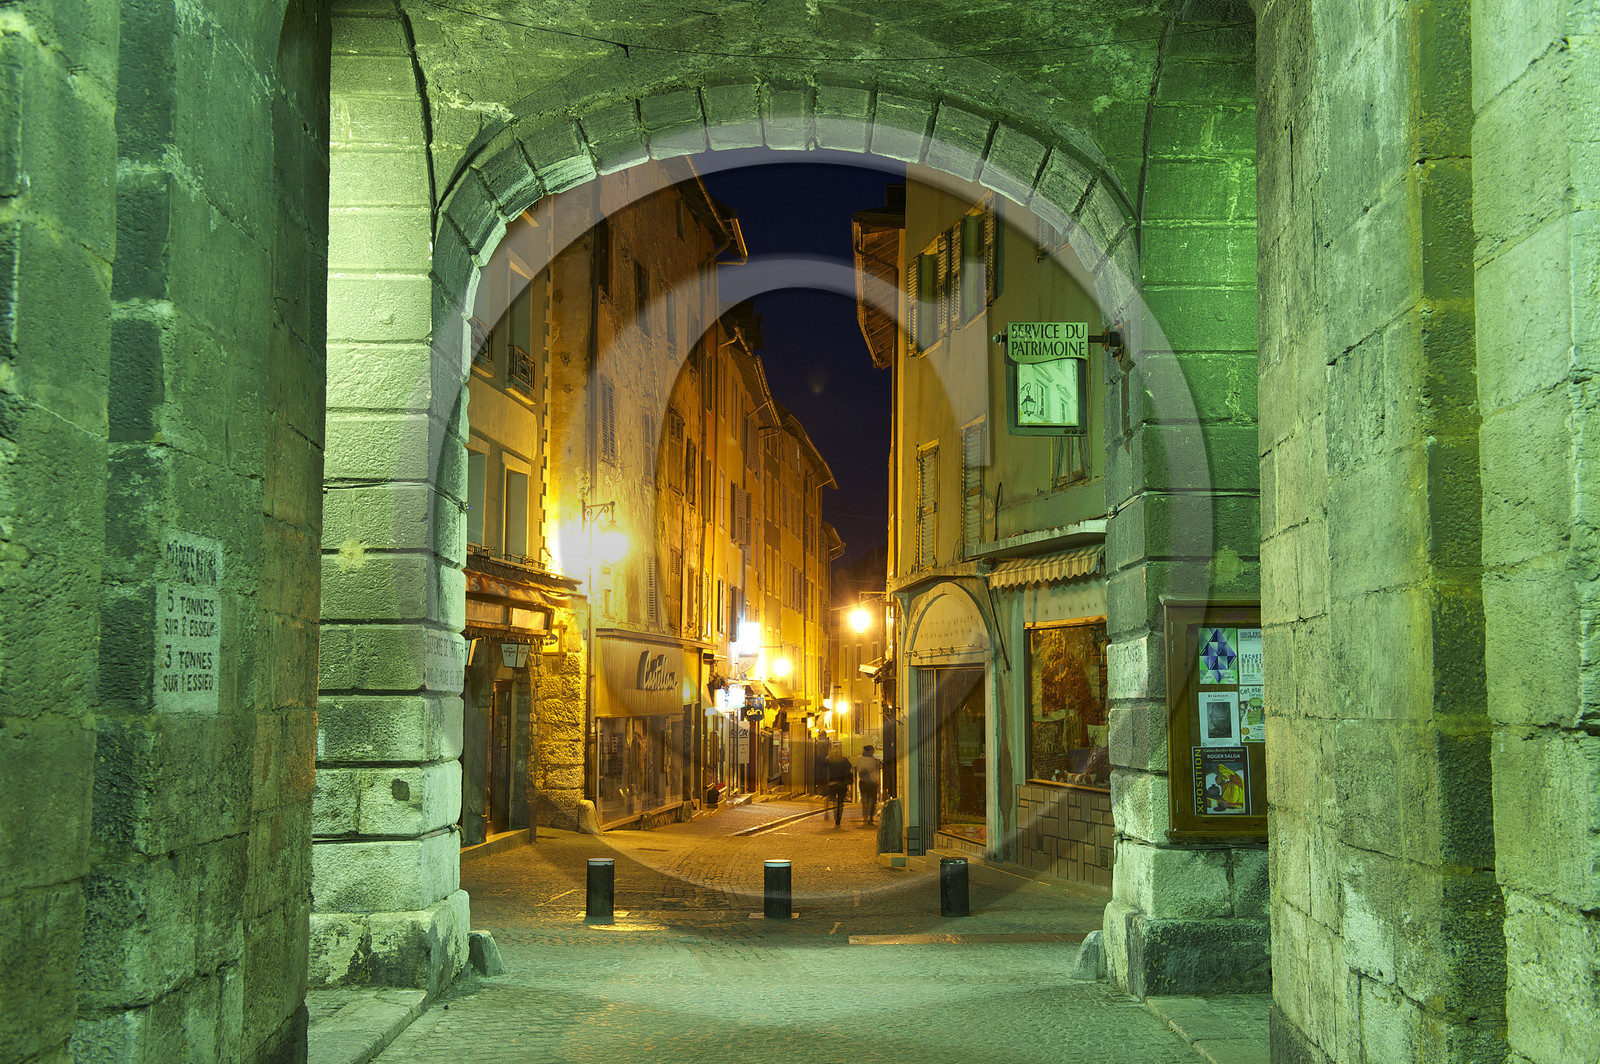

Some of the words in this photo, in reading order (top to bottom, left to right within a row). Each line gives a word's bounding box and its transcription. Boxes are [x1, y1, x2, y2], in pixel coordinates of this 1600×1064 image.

[1011, 324, 1060, 339] SERVICE
[1066, 324, 1085, 339] DU
[1011, 341, 1085, 356] PATRIMOINE
[168, 589, 174, 612] 5
[180, 596, 215, 617] TONNES
[165, 618, 179, 635] SUR
[165, 644, 172, 669] 3
[179, 651, 212, 670] TONNES
[163, 674, 178, 692] SUR
[187, 673, 213, 691] ESSIEU
[1195, 749, 1204, 814] XPOSITION
